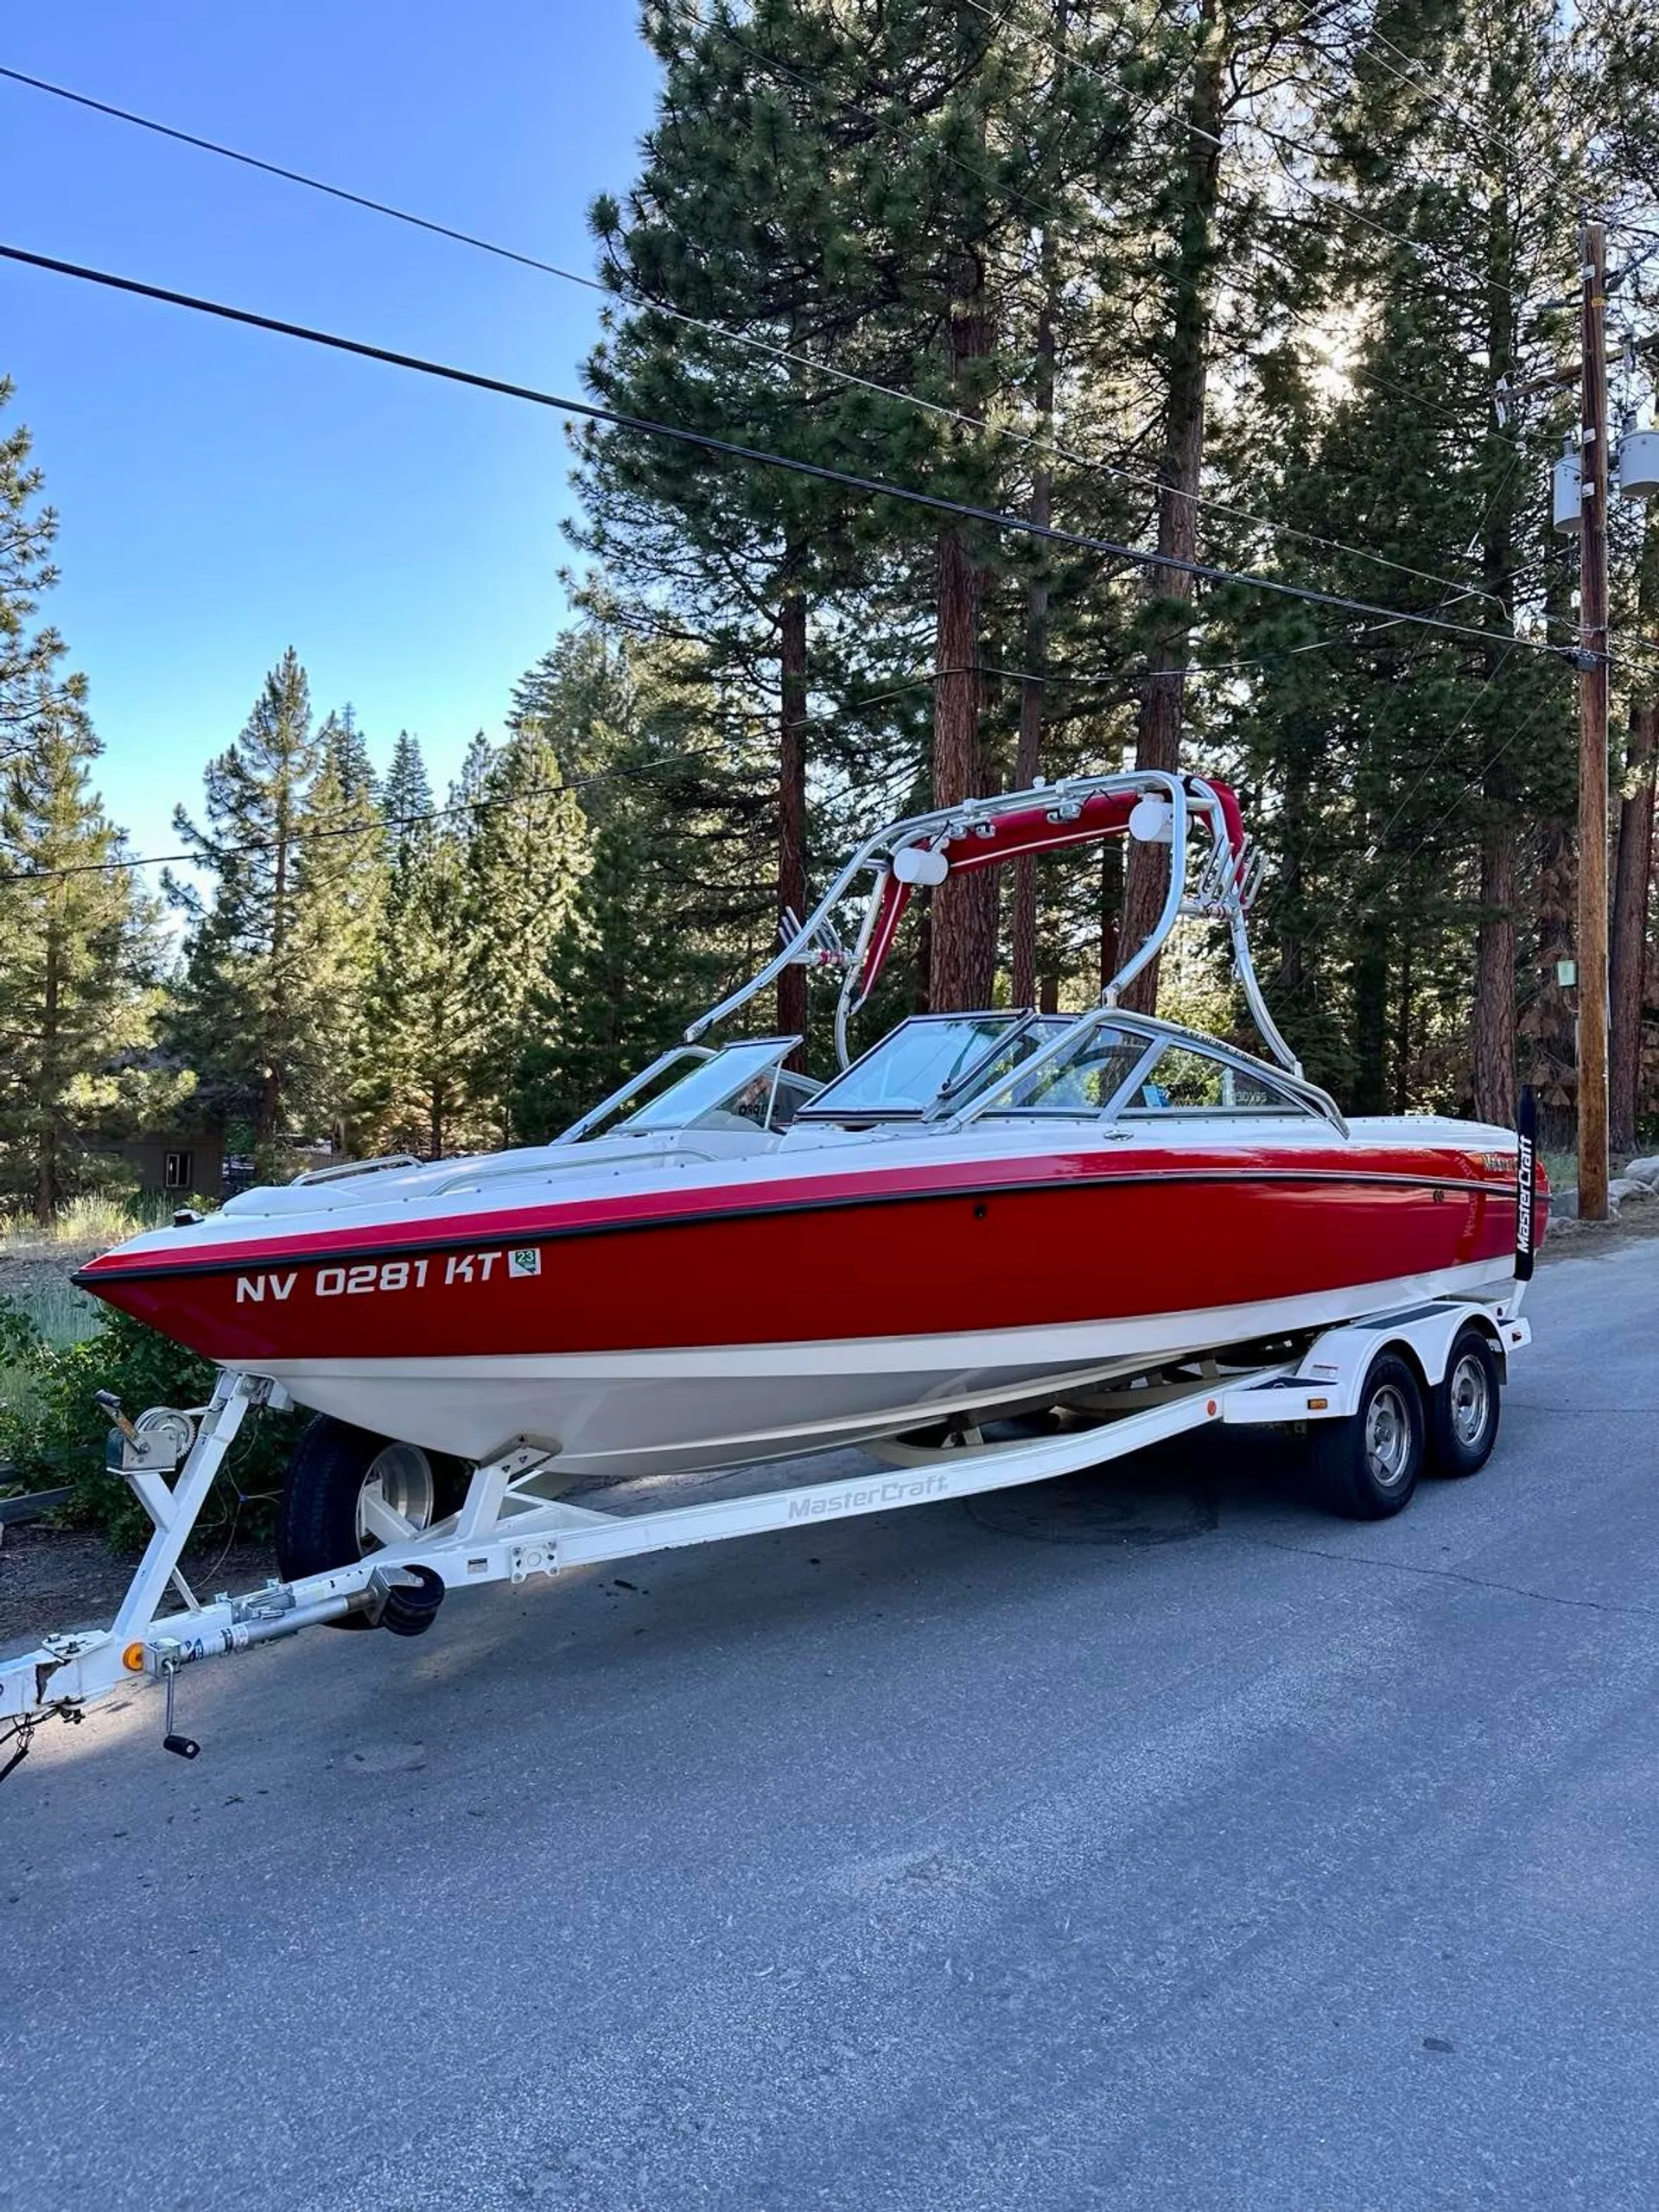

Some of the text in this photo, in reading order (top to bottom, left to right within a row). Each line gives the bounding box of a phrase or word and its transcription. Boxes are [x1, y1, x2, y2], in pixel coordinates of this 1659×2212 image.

[1516, 1134, 1533, 1254] MasterCraft
[236, 1251, 502, 1303] NV 0281 KT
[517, 1250, 534, 1262] 23
[788, 1474, 948, 1520] MasterCraft
